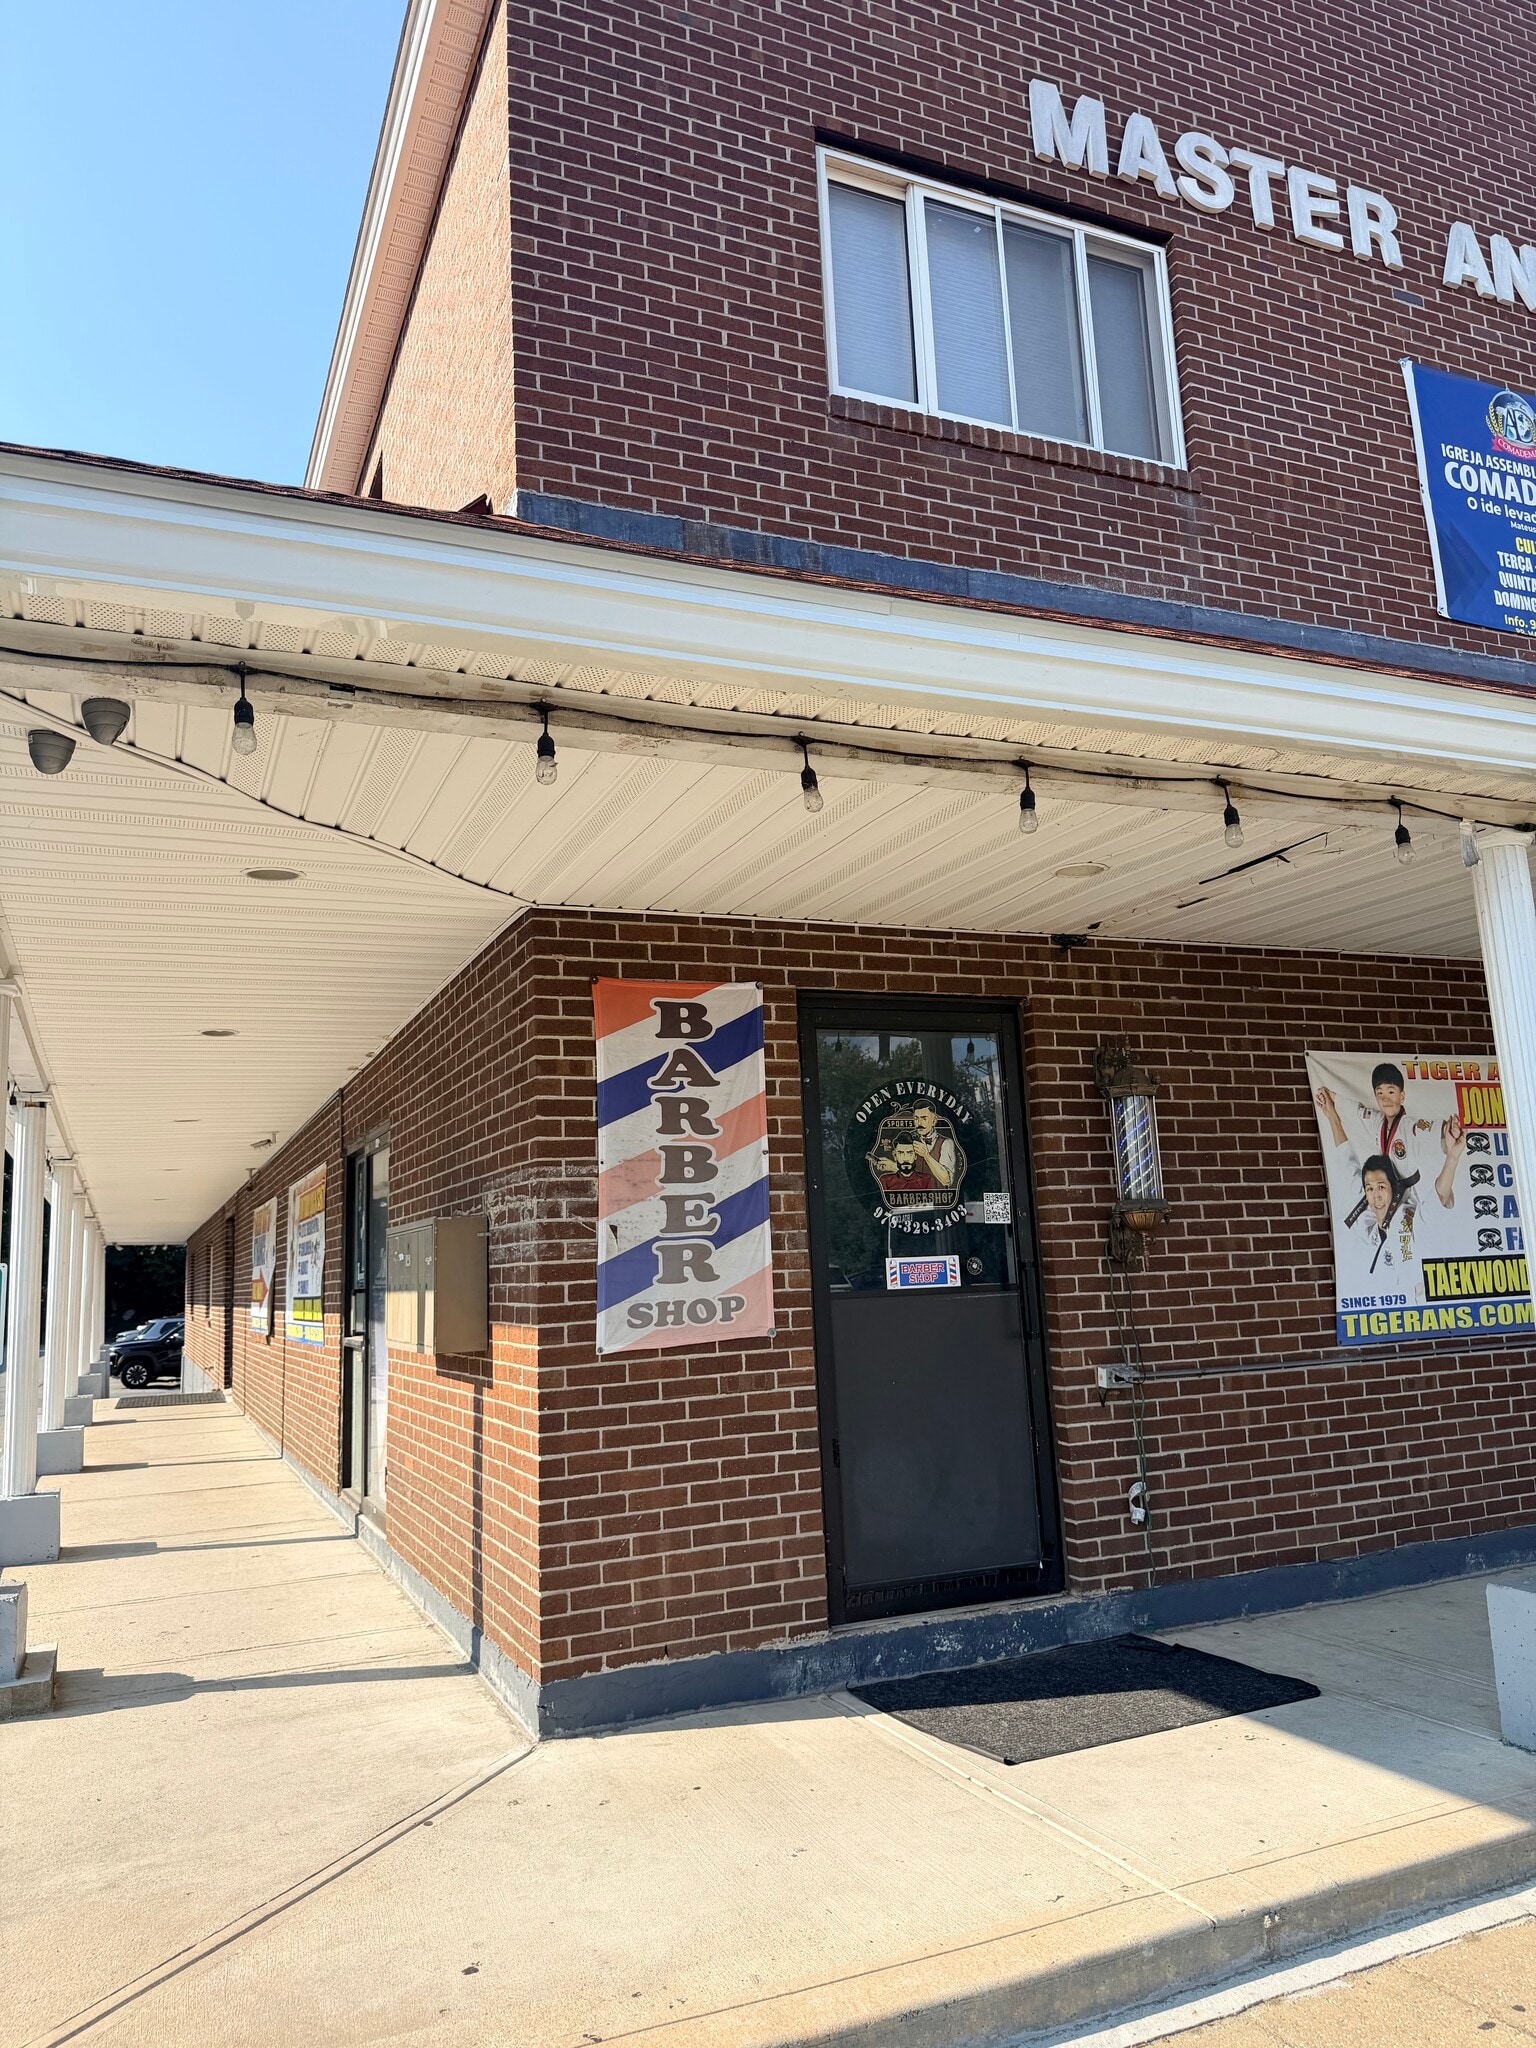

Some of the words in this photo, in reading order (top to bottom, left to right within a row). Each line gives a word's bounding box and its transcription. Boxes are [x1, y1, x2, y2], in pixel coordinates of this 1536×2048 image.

[1029, 78, 1404, 271] MASTER
[1441, 443, 1483, 466] IGREJA
[1444, 461, 1536, 506] COMAD
[1466, 496, 1478, 510] O
[1481, 499, 1502, 516] ide
[1515, 537, 1536, 556] CUL
[1496, 551, 1533, 573] TERÇA
[1504, 614, 1528, 628] Info.
[1401, 1060, 1481, 1081] TIGER
[855, 1086, 892, 1123] OPEN
[895, 1081, 973, 1124] EVERYDAY
[1461, 1086, 1507, 1126] JOIN
[886, 1120, 913, 1128] SPORTS
[648, 999, 721, 1285] BARBER
[889, 1192, 954, 1205] BARBERSHOP
[901, 1263, 945, 1274] BARBER
[908, 1273, 939, 1284] SHOP
[626, 1295, 746, 1329] SHOP
[1341, 1296, 1377, 1309] SINCE
[1378, 1294, 1407, 1307] 1979
[1341, 1302, 1535, 1338] TIGERANS.COM
